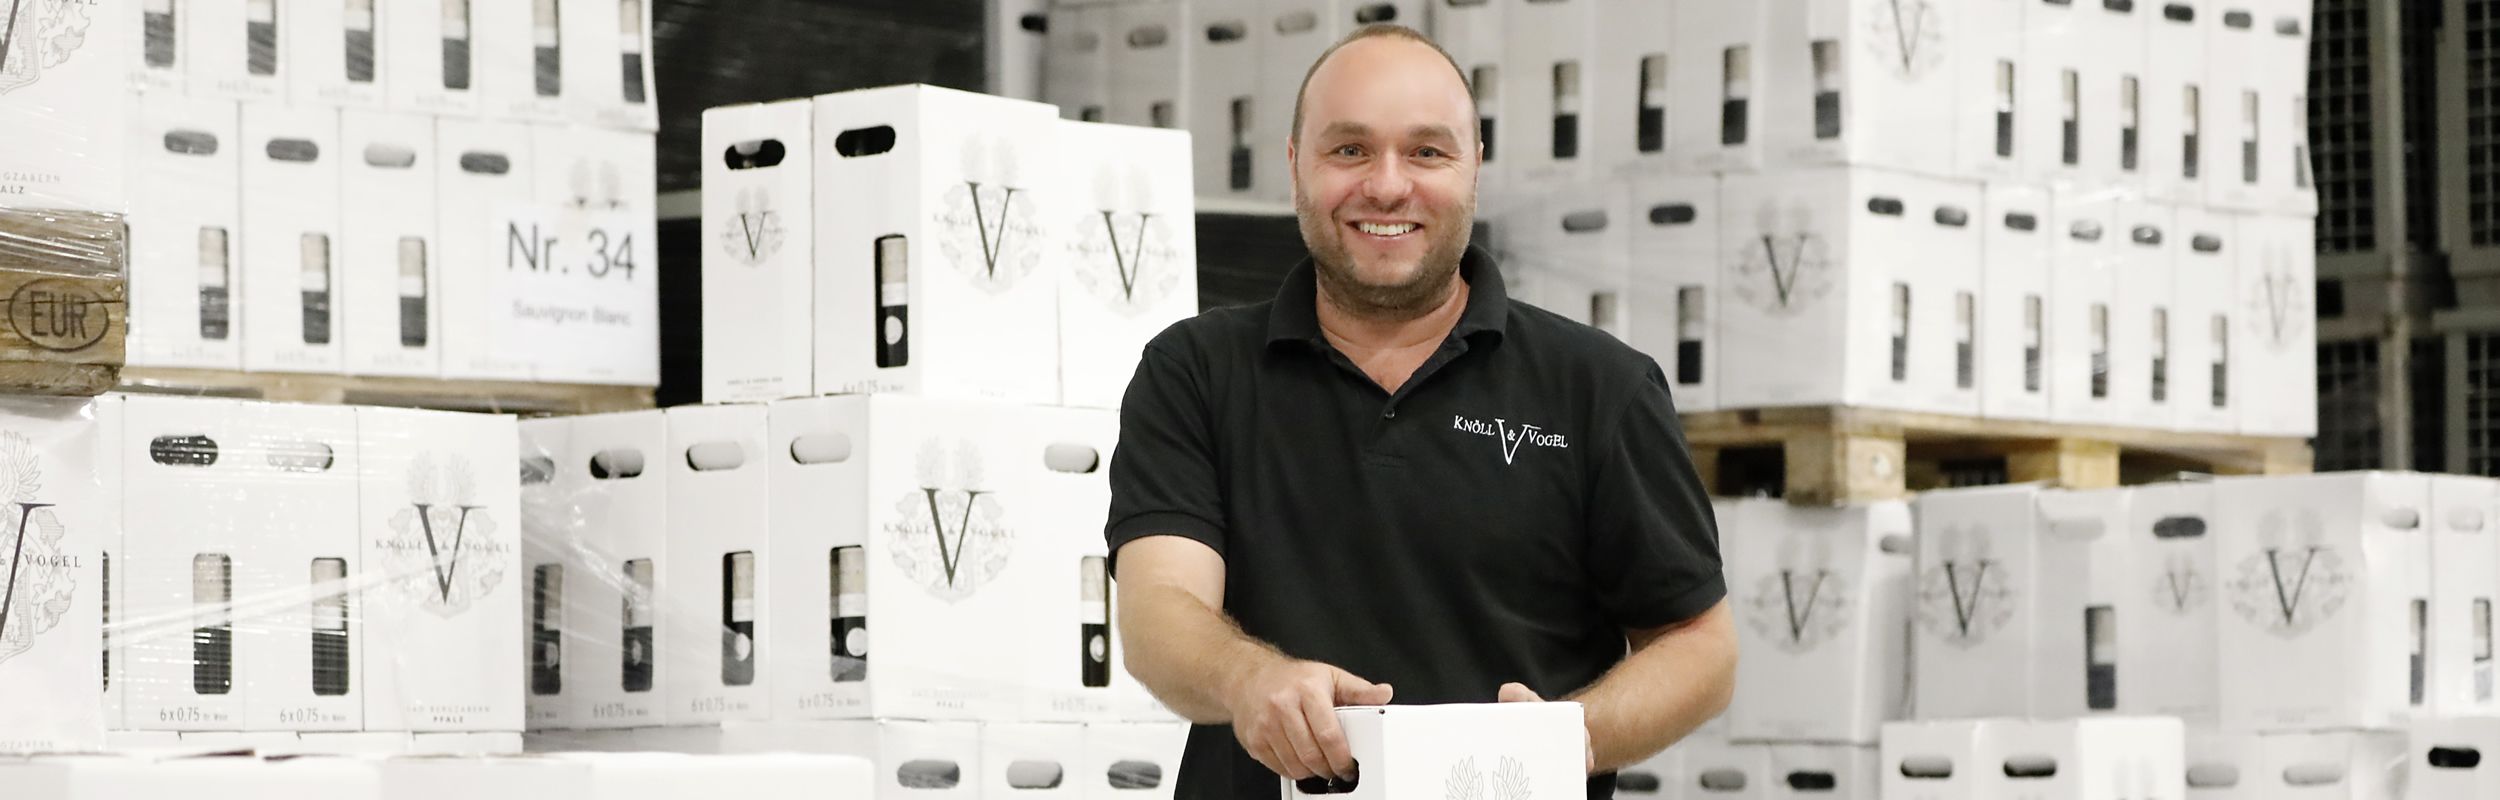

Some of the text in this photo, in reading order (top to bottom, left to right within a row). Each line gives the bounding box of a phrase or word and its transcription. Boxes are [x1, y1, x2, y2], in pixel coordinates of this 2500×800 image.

[508, 221, 636, 281] Nr. 34
[963, 180, 1029, 283] V
[1097, 209, 1164, 304] V
[30, 291, 87, 339] EUR
[513, 300, 632, 327] Sauvignon Blanc
[1453, 415, 1568, 448] KNÖLL & VOGEL
[1495, 418, 1541, 465] V
[25, 554, 81, 568] VOGEL
[411, 502, 488, 606] V
[920, 487, 995, 591] V
